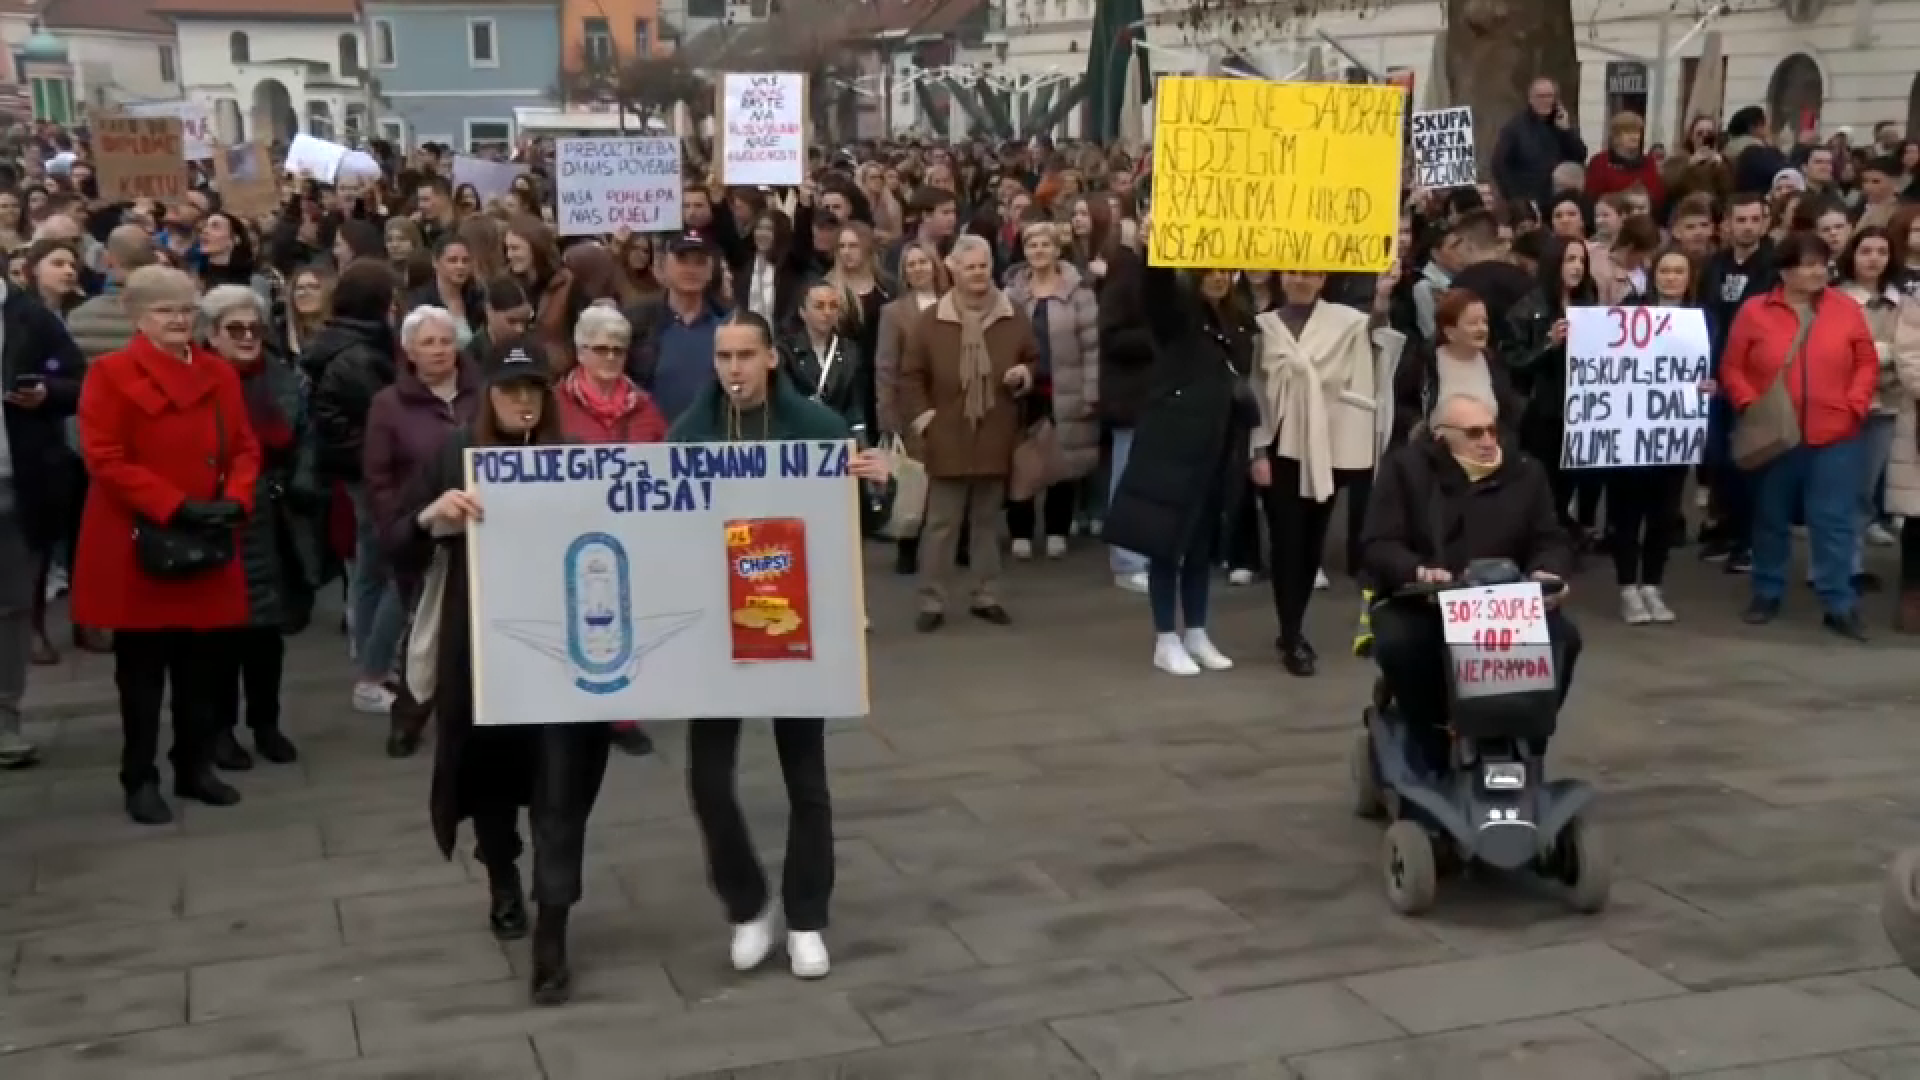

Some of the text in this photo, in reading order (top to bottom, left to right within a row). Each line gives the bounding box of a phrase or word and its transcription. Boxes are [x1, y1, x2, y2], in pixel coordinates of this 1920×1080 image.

[1413, 109, 1470, 132] SKUPA
[1415, 130, 1465, 148] KARTA
[568, 207, 603, 225] NAS
[1607, 307, 1672, 348] 30%
[1627, 391, 1633, 419] I
[1564, 426, 1706, 466] KLIME NEMA
[669, 444, 767, 479] NEMAMO
[779, 442, 808, 477] NI
[816, 442, 849, 477] ZA
[1445, 600, 1482, 623] 30%
[1455, 655, 1550, 683] NEPRAVDA
